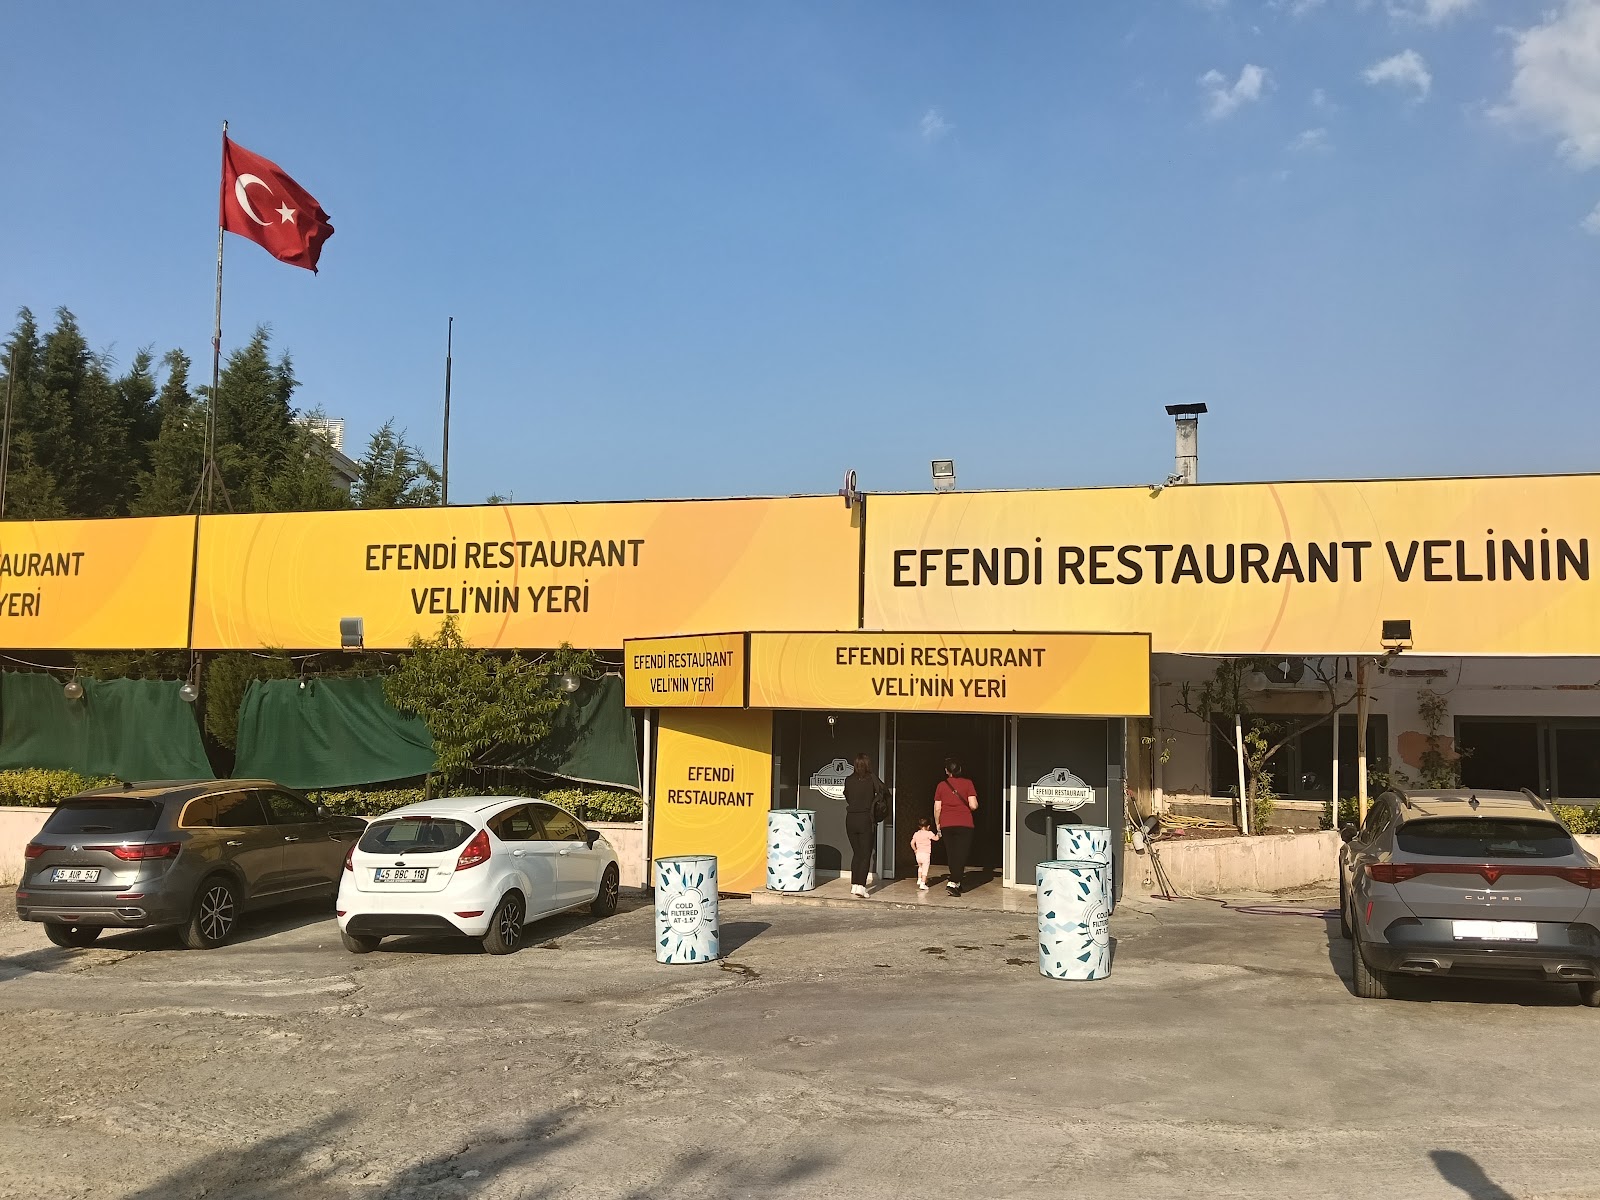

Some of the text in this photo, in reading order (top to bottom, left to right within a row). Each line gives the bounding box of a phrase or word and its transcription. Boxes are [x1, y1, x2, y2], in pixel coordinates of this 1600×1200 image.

[366, 537, 645, 571] EFENDİ RESTAURANT
[894, 528, 1589, 586] EFENDİ RESTAURANT VELİNİN
[0, 552, 85, 577] AURANT
[411, 579, 589, 614] VELİ'NİN YERİ
[634, 651, 734, 669] EFENDİ RESTAURANT
[837, 643, 1046, 668] EFENDİ RESTAURANT
[692, 673, 714, 692] YERİ
[872, 674, 1006, 698] VELİ'NİN YERİ
[688, 764, 734, 783] EFENDİ
[668, 789, 753, 807] RESTAURANT
[56, 870, 65, 879] 45
[85, 870, 98, 879] 547
[380, 869, 390, 879] 45
[414, 869, 426, 879] 118
[671, 909, 699, 917] FILTERED
